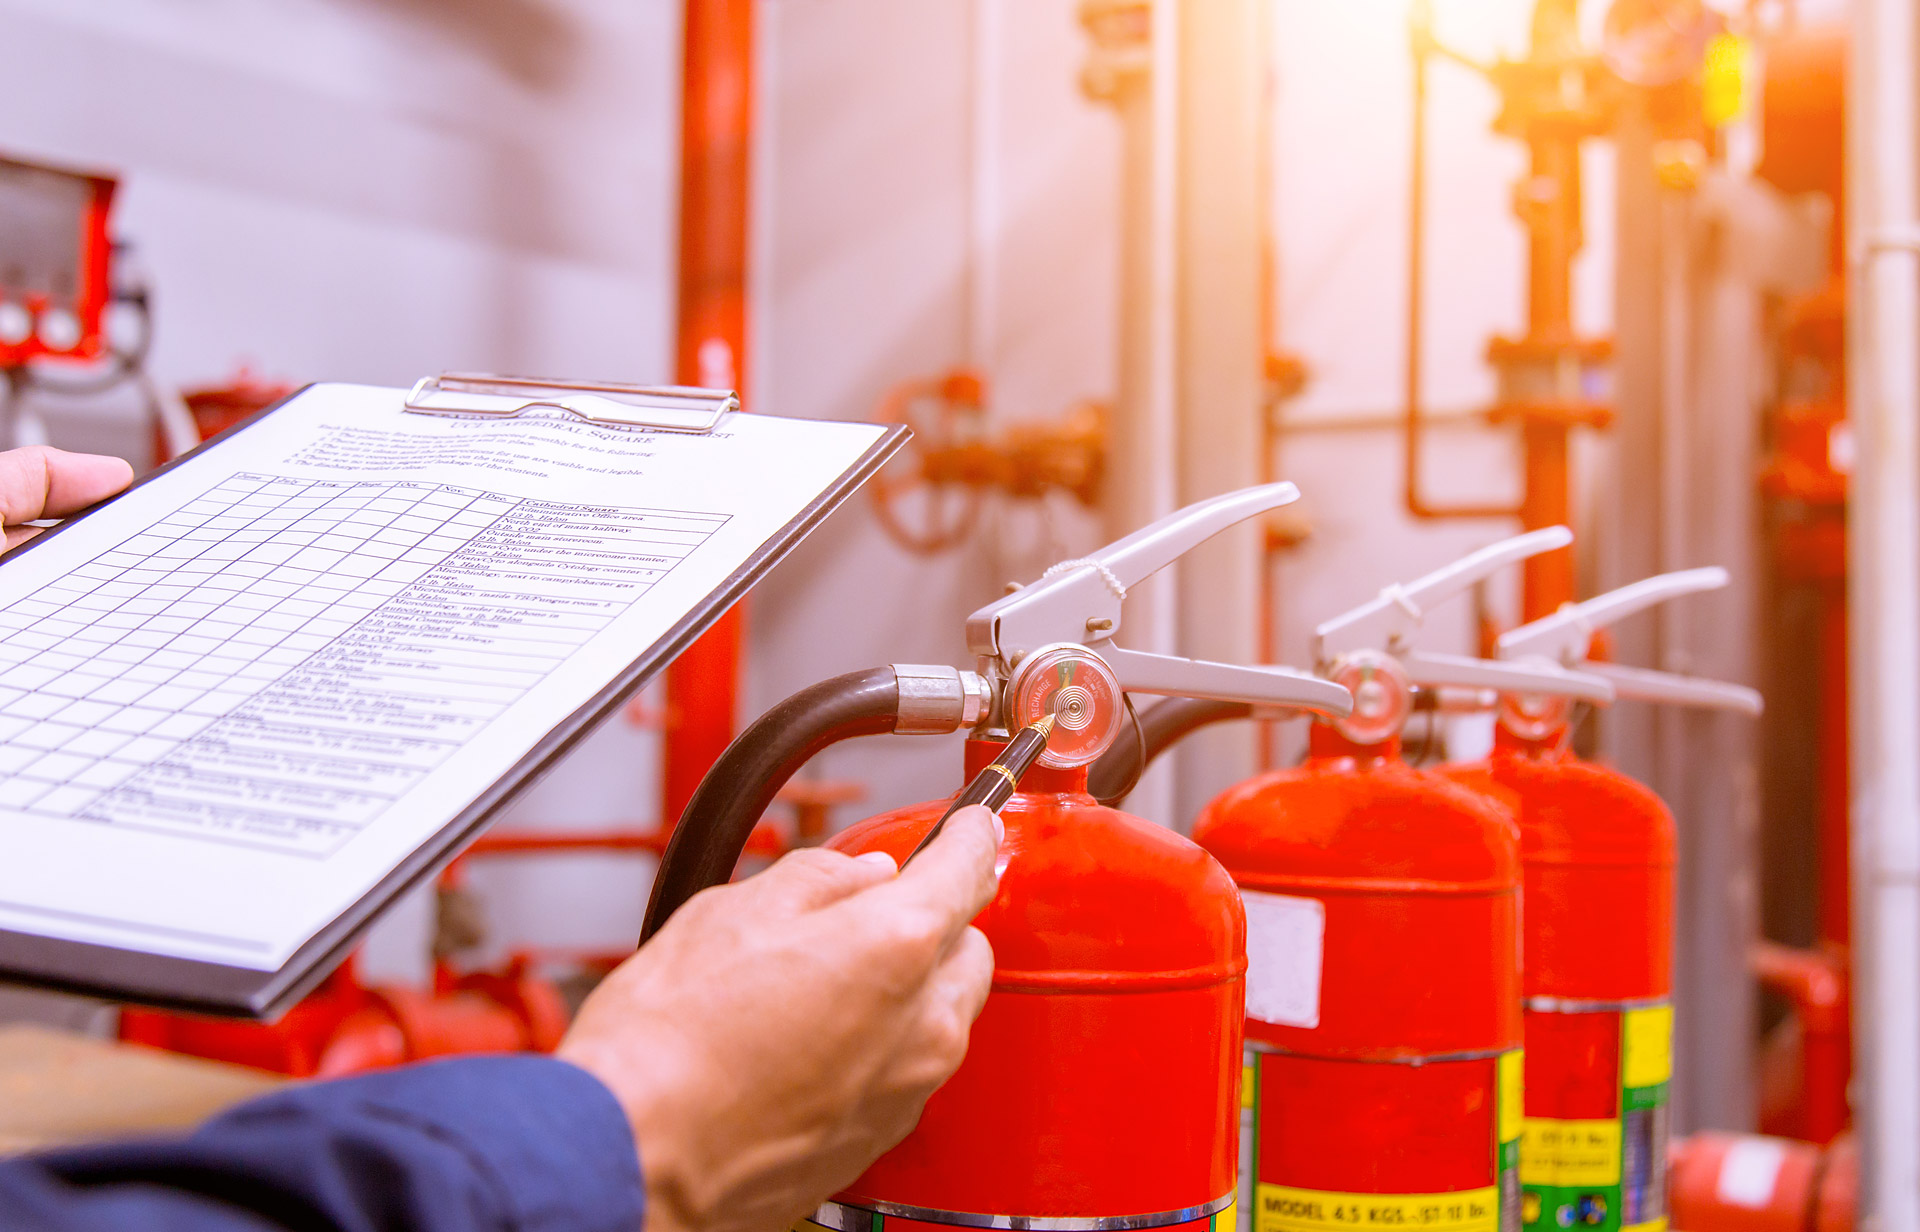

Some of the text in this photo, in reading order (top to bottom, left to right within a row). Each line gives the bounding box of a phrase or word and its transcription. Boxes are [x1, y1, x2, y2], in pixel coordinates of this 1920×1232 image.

[491, 421, 655, 443] CATHEDRAL SQUARE
[330, 437, 357, 445] There
[528, 435, 570, 447] monthly
[571, 442, 587, 450] for
[312, 448, 339, 456] There
[491, 458, 515, 466] unit.
[434, 458, 473, 467] leakage
[486, 463, 504, 471] the
[504, 467, 550, 479] contents.
[495, 450, 511, 458] for
[512, 453, 531, 461] use
[552, 460, 584, 470] visible
[586, 466, 608, 474] and
[608, 469, 644, 477] legible.
[516, 506, 590, 517] Administrative
[525, 500, 580, 511] Cathedral
[501, 518, 531, 526] North
[591, 525, 632, 534] hallway.
[486, 529, 524, 539] Outside
[552, 537, 605, 545] storeroom.
[501, 538, 531, 546] Halon
[491, 550, 522, 558] Halon
[573, 552, 627, 560] microtome
[627, 556, 668, 564] counter.
[459, 561, 491, 569] Halon
[506, 559, 556, 569] alongside
[557, 563, 602, 572] Cytology
[443, 581, 475, 589] Halon
[540, 577, 615, 588] campylobacter
[417, 593, 448, 602] Halon
[373, 612, 416, 621] Central
[415, 616, 467, 625] Computer
[381, 606, 433, 616] autoclave
[490, 614, 523, 623] Halon
[513, 610, 547, 618] phone
[353, 625, 386, 633] South
[335, 639, 379, 649] Hallway
[1031, 678, 1053, 719] RECHARGE
[1264, 1197, 1324, 1221] MODEL
[1333, 1203, 1362, 1224] 4.5
